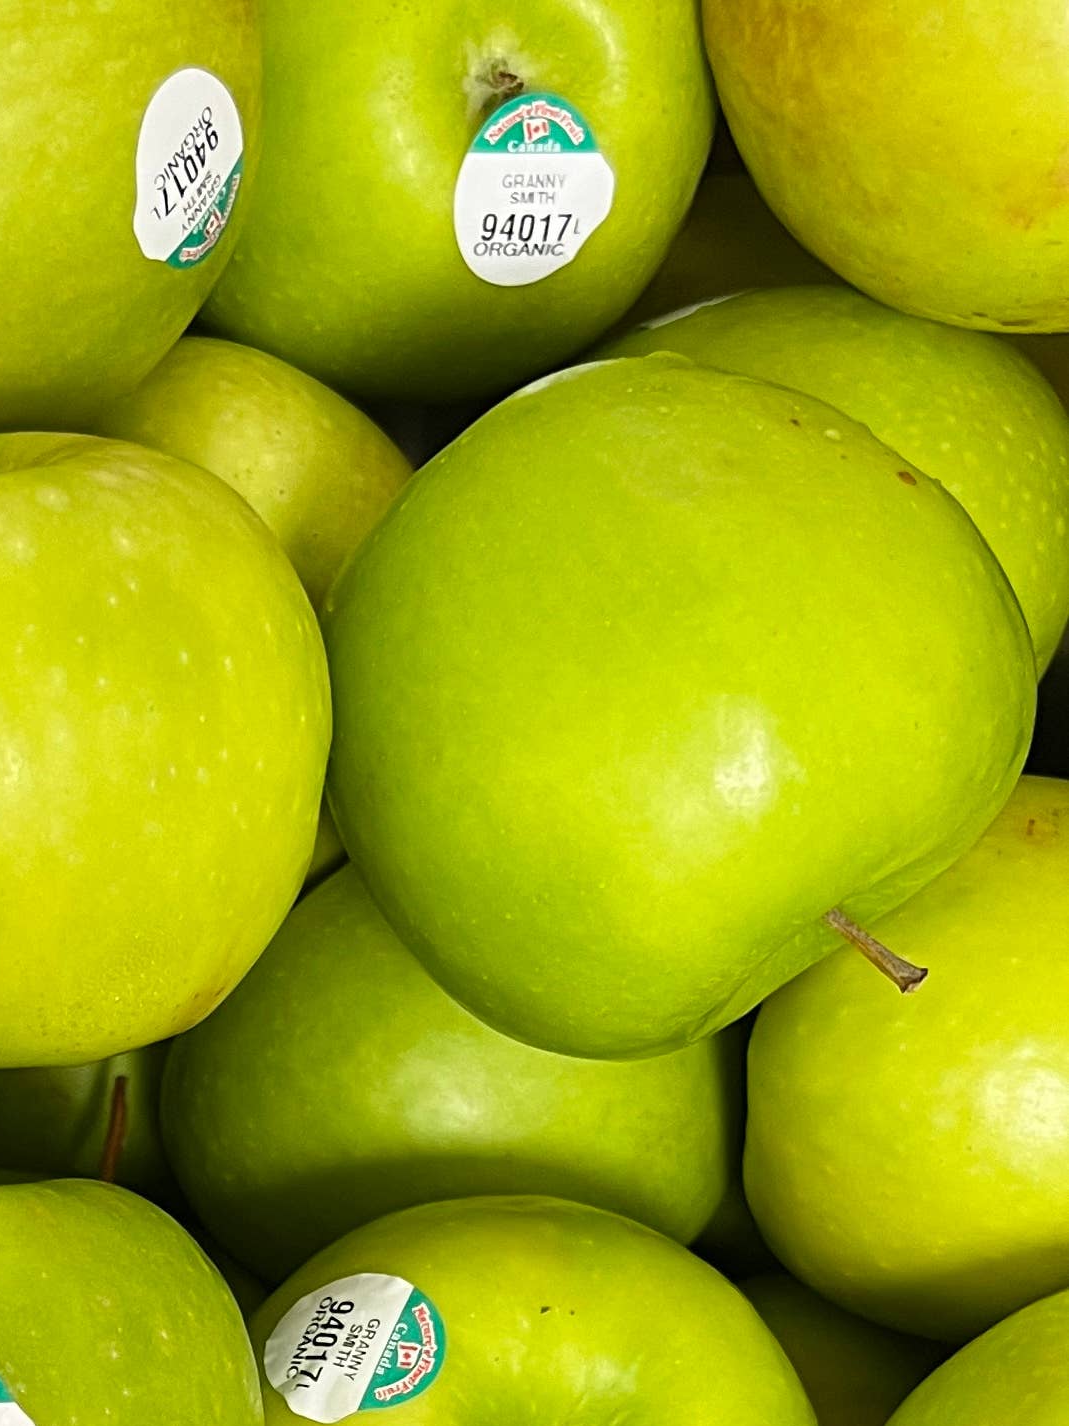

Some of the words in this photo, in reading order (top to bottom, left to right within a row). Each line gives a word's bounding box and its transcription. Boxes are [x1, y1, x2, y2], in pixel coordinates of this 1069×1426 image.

[154, 107, 212, 190] ORGANIC
[507, 139, 561, 153] Canada
[182, 174, 221, 235] GRANNY
[502, 174, 567, 189] GRANNY
[510, 192, 555, 205] SMITH
[473, 242, 564, 257] ORGANIC
[287, 1296, 333, 1380] ORGANIC
[333, 1324, 363, 1368] SMITH
[345, 1319, 380, 1381] GRANNY
[376, 1323, 408, 1375] Canada
